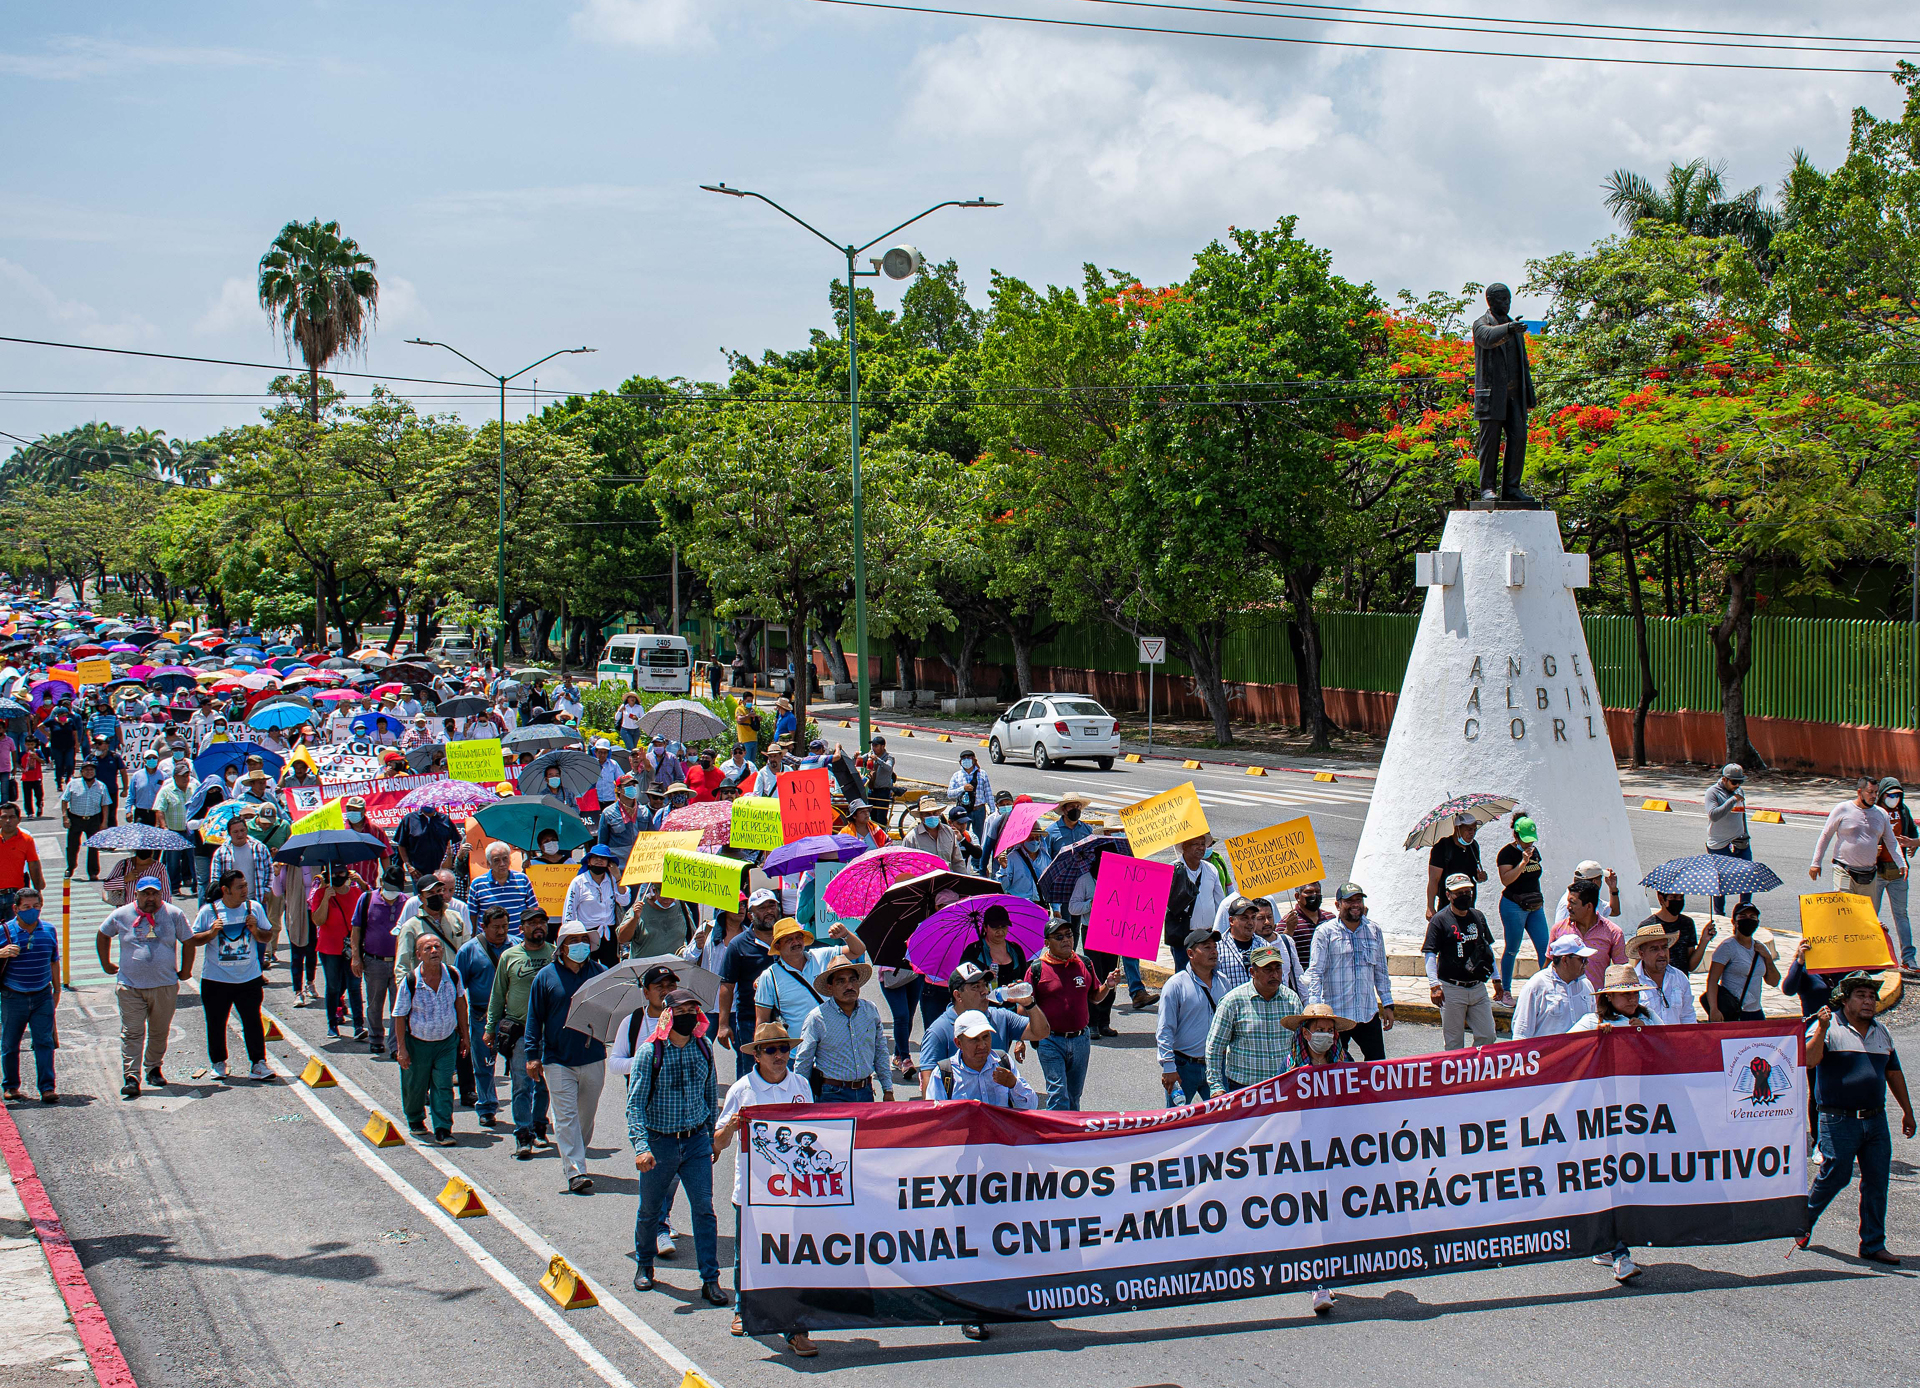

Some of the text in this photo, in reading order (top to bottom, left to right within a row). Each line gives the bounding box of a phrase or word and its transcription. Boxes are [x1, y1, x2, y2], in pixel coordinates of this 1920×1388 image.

[322, 780, 370, 799] JUBILADOS
[369, 781, 378, 794] Y
[377, 774, 437, 793] PENSIONADOS
[791, 780, 815, 794] NO
[789, 798, 798, 811] A
[1121, 808, 1134, 818] NO
[1124, 796, 1184, 828] HOSTIGAMIENTO
[784, 820, 827, 838] USICAMM
[1128, 830, 1134, 838] Y
[1132, 820, 1193, 850] ADMINISTRATIVA
[1229, 836, 1257, 848] NO AL
[1230, 830, 1306, 862] HOSTIGAMIENTO
[666, 858, 671, 872] Y
[1124, 865, 1146, 882] NO
[1236, 864, 1242, 876] Y
[1241, 858, 1318, 890] ADMINISTRATIVA
[663, 875, 732, 898] ADMINISTRATIVA
[1106, 890, 1154, 914] A LA
[1837, 907, 1853, 916] 1971
[1241, 1080, 1288, 1108] DEL
[1296, 1062, 1432, 1099] SNTE-CNTE
[1440, 1050, 1540, 1085] CHIAPAS
[1730, 1107, 1794, 1119] Venceremos
[898, 1103, 1677, 1210] ¡EXIGIMOS REINSTALACIÓN DE LA MESA
[767, 1172, 844, 1198] CNTE
[761, 1144, 1791, 1266] NACIONAL CNTE-AMLO CON CARÁCTER RESOLUTIVO!
[1028, 1228, 1572, 1312] UNIDOS, ORGANIZADOS Y DISCIPLINADOS, ¡VENCEREMOS!
